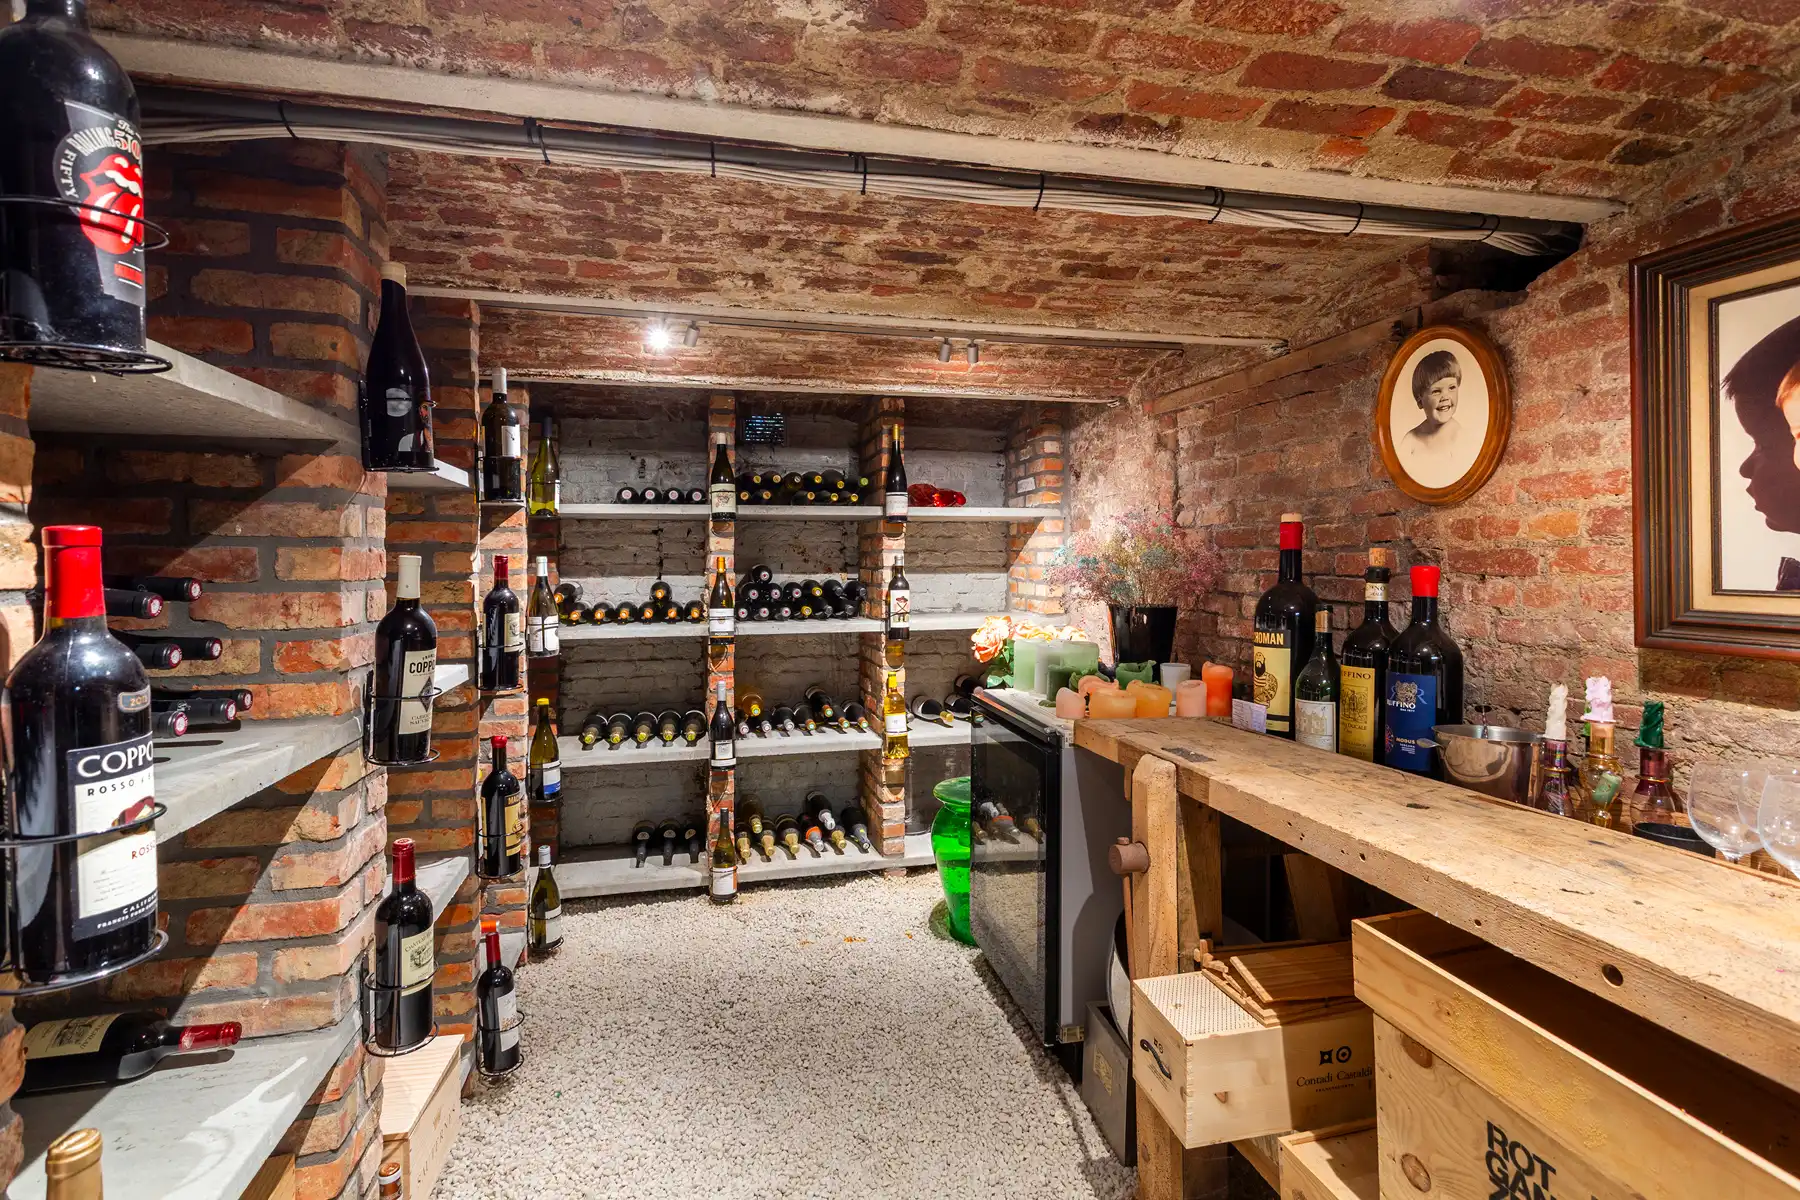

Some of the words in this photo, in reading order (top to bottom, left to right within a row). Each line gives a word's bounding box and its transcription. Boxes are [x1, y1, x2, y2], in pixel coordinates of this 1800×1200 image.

[66, 127, 116, 157] ROLLING
[60, 149, 79, 198] FIFTY
[88, 779, 135, 796] ROSSO
[1296, 1072, 1333, 1087] Contadi
[1337, 1066, 1373, 1080] Castaldi
[1486, 1120, 1557, 1192] ROT
